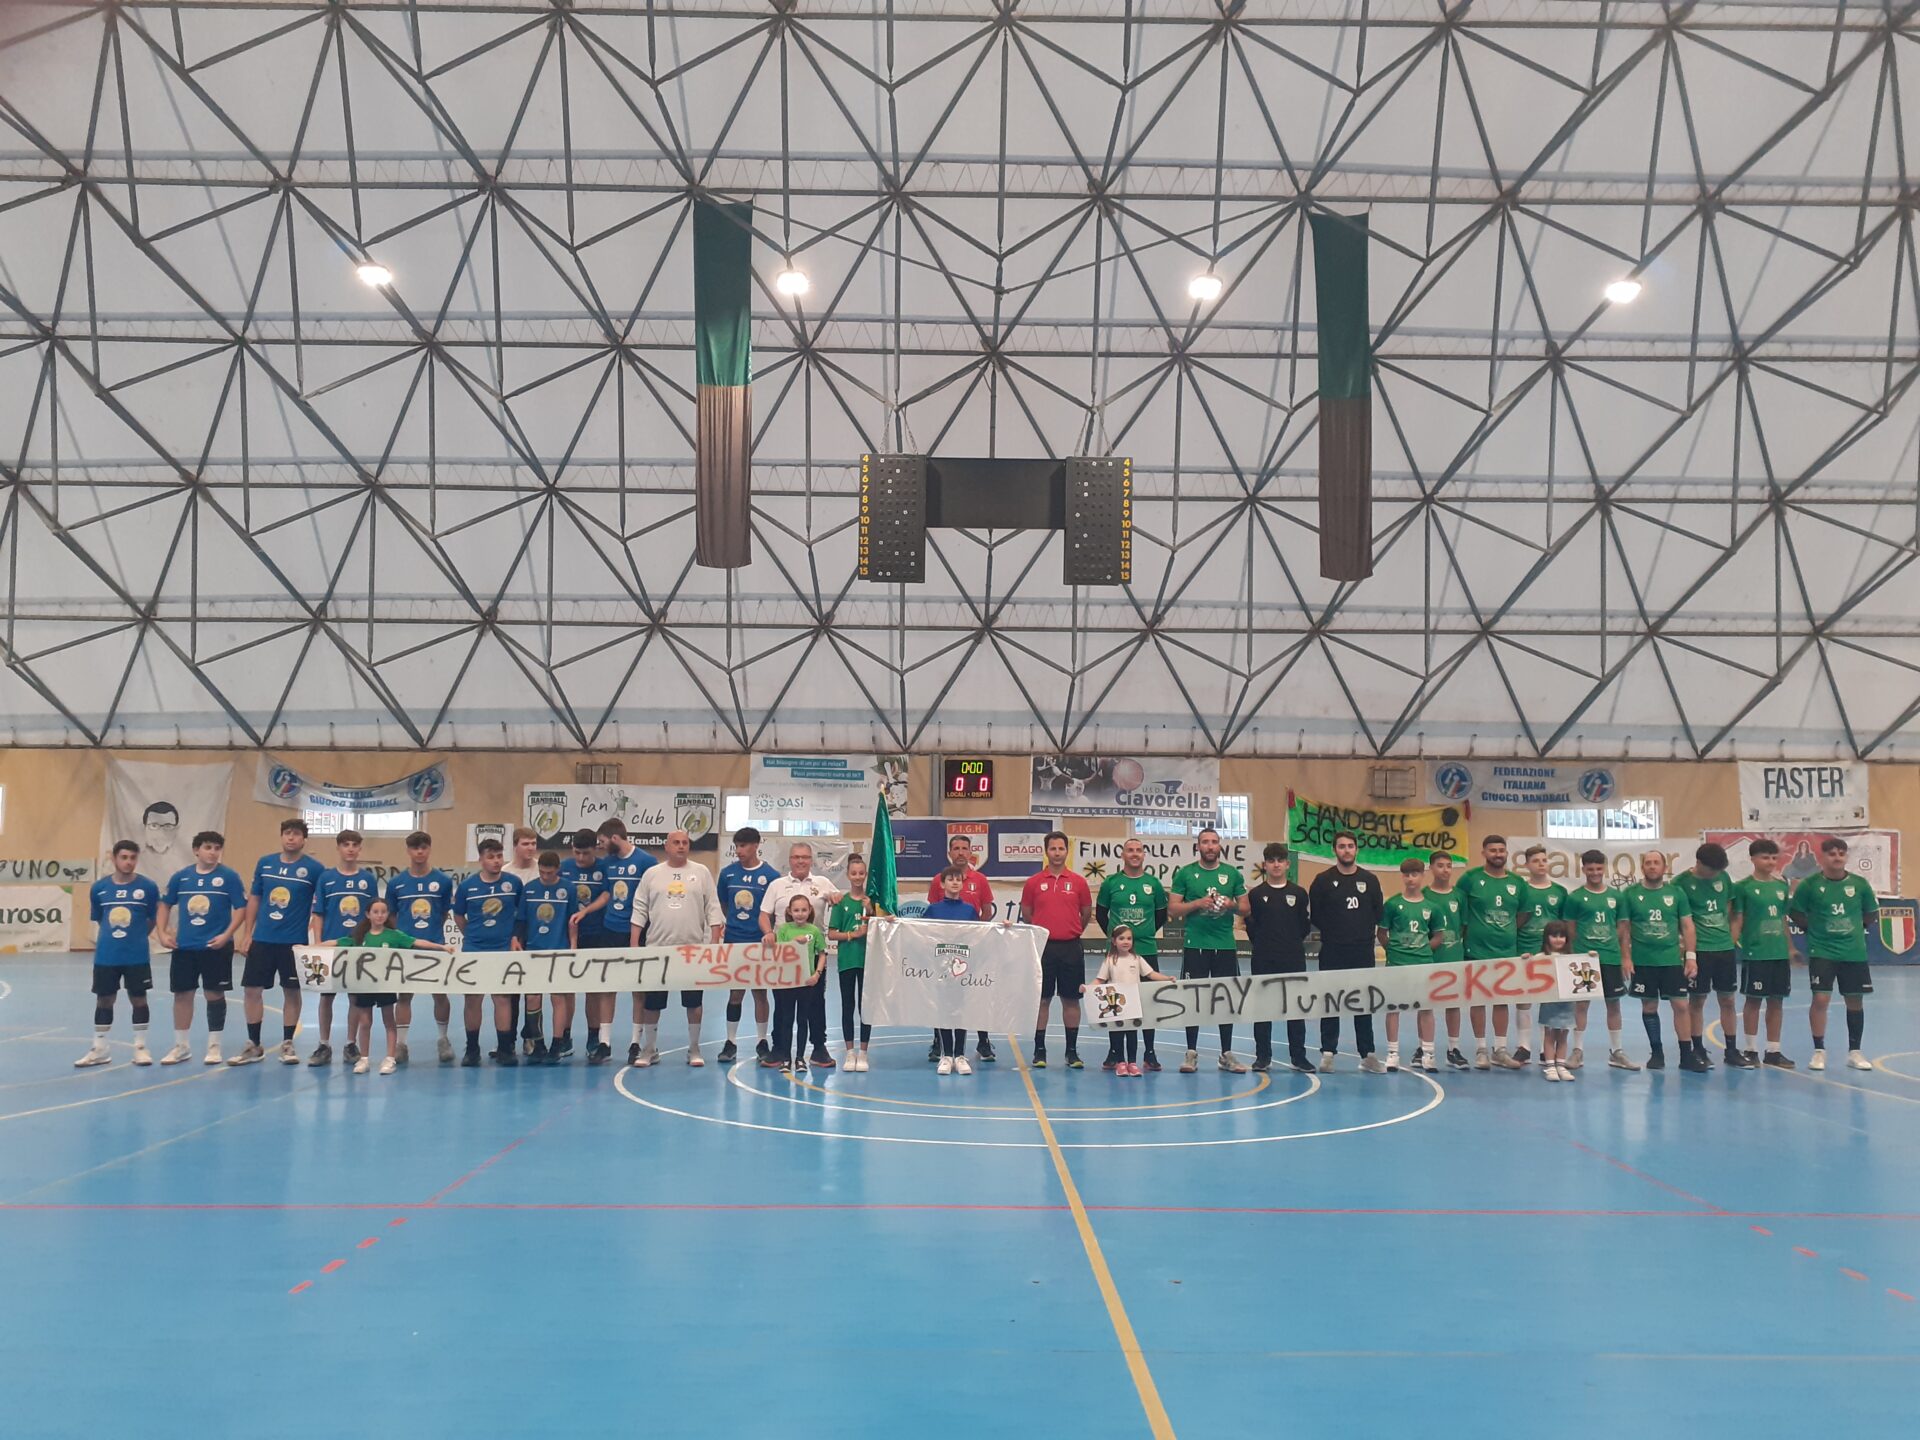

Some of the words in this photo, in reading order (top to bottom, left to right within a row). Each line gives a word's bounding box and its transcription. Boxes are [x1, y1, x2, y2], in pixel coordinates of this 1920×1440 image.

[862, 455, 869, 463] 4
[1123, 458, 1130, 466] 4
[862, 465, 869, 473] 5
[1123, 468, 1130, 477] 5
[862, 475, 869, 483] 6
[1123, 479, 1130, 487] 6
[862, 485, 869, 493] 7
[1123, 489, 1130, 497] 7
[862, 495, 868, 503] 8
[1123, 499, 1129, 507] 8
[862, 505, 868, 513] 9
[860, 516, 870, 524] 10
[1121, 520, 1131, 528] 10
[861, 526, 868, 534] 11
[1122, 530, 1129, 538] 11
[860, 537, 869, 545] 12
[1121, 541, 1130, 549] 12
[860, 547, 869, 555] 13
[1121, 551, 1130, 559] 13
[860, 557, 869, 565] 14
[860, 567, 868, 575] 15
[1121, 572, 1130, 580] 15
[961, 762, 983, 773] 0:00
[1494, 767, 1556, 777] FEDERAZIONE
[955, 777, 964, 791] 0
[980, 777, 988, 791] 0
[1503, 780, 1546, 790] ITALIANA
[1763, 767, 1844, 799] FASTER
[531, 797, 565, 805] HANDBALL
[677, 798, 714, 806] HANDBALL
[1115, 791, 1211, 809] Ciavorella
[580, 797, 608, 818] fan
[631, 808, 665, 825] club
[1303, 802, 1414, 833] HANDBALL
[952, 825, 985, 833] F.I.G.H.
[1292, 824, 1335, 846] SCIC
[1413, 831, 1457, 850] CLUB
[1004, 845, 1043, 854] DRAGO
[1079, 841, 1124, 859] FINO
[1192, 843, 1246, 861] FNE
[279, 867, 287, 875] 14
[1129, 893, 1136, 905] 9
[1346, 896, 1359, 909] 20
[1495, 895, 1502, 907] 8
[1535, 904, 1542, 917] 5
[1706, 900, 1717, 912] 21
[1831, 903, 1845, 915] 34
[1594, 912, 1606, 923] 31
[1649, 909, 1662, 921] 28
[1409, 920, 1419, 933] 12
[676, 944, 734, 964] FAN
[331, 950, 478, 988] GRAZIE
[501, 961, 526, 985] A
[531, 953, 670, 984] TUTTI
[694, 965, 802, 986] SCICLI
[960, 974, 994, 987] club
[1428, 959, 1555, 1002] 2K25
[1634, 983, 1646, 993] 28
[1753, 981, 1763, 990] 10
[1153, 977, 1252, 1022] STAY
